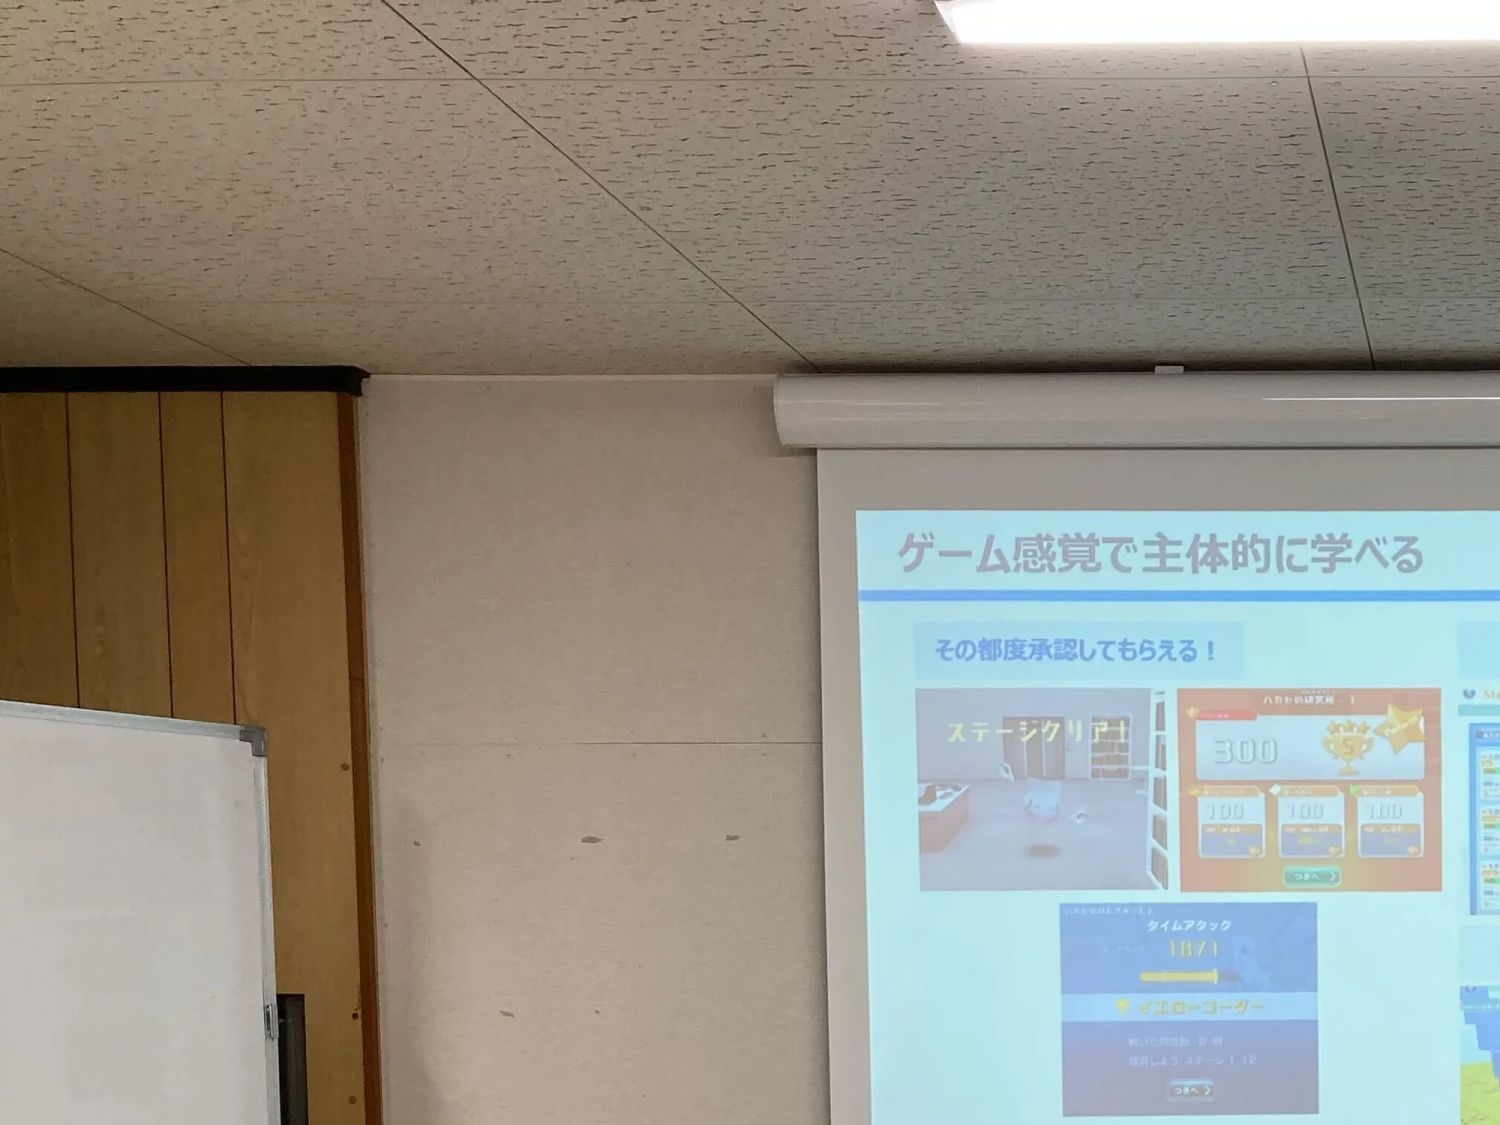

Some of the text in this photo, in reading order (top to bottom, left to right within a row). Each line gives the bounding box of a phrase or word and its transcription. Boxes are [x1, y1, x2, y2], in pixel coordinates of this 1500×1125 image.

[898, 531, 1424, 575] ゲーム感覚で主体的に学べる
[1213, 737, 1279, 765] 300
[1206, 803, 1245, 821] 100
[1287, 803, 1325, 821] 100
[1366, 803, 1403, 821] 100
